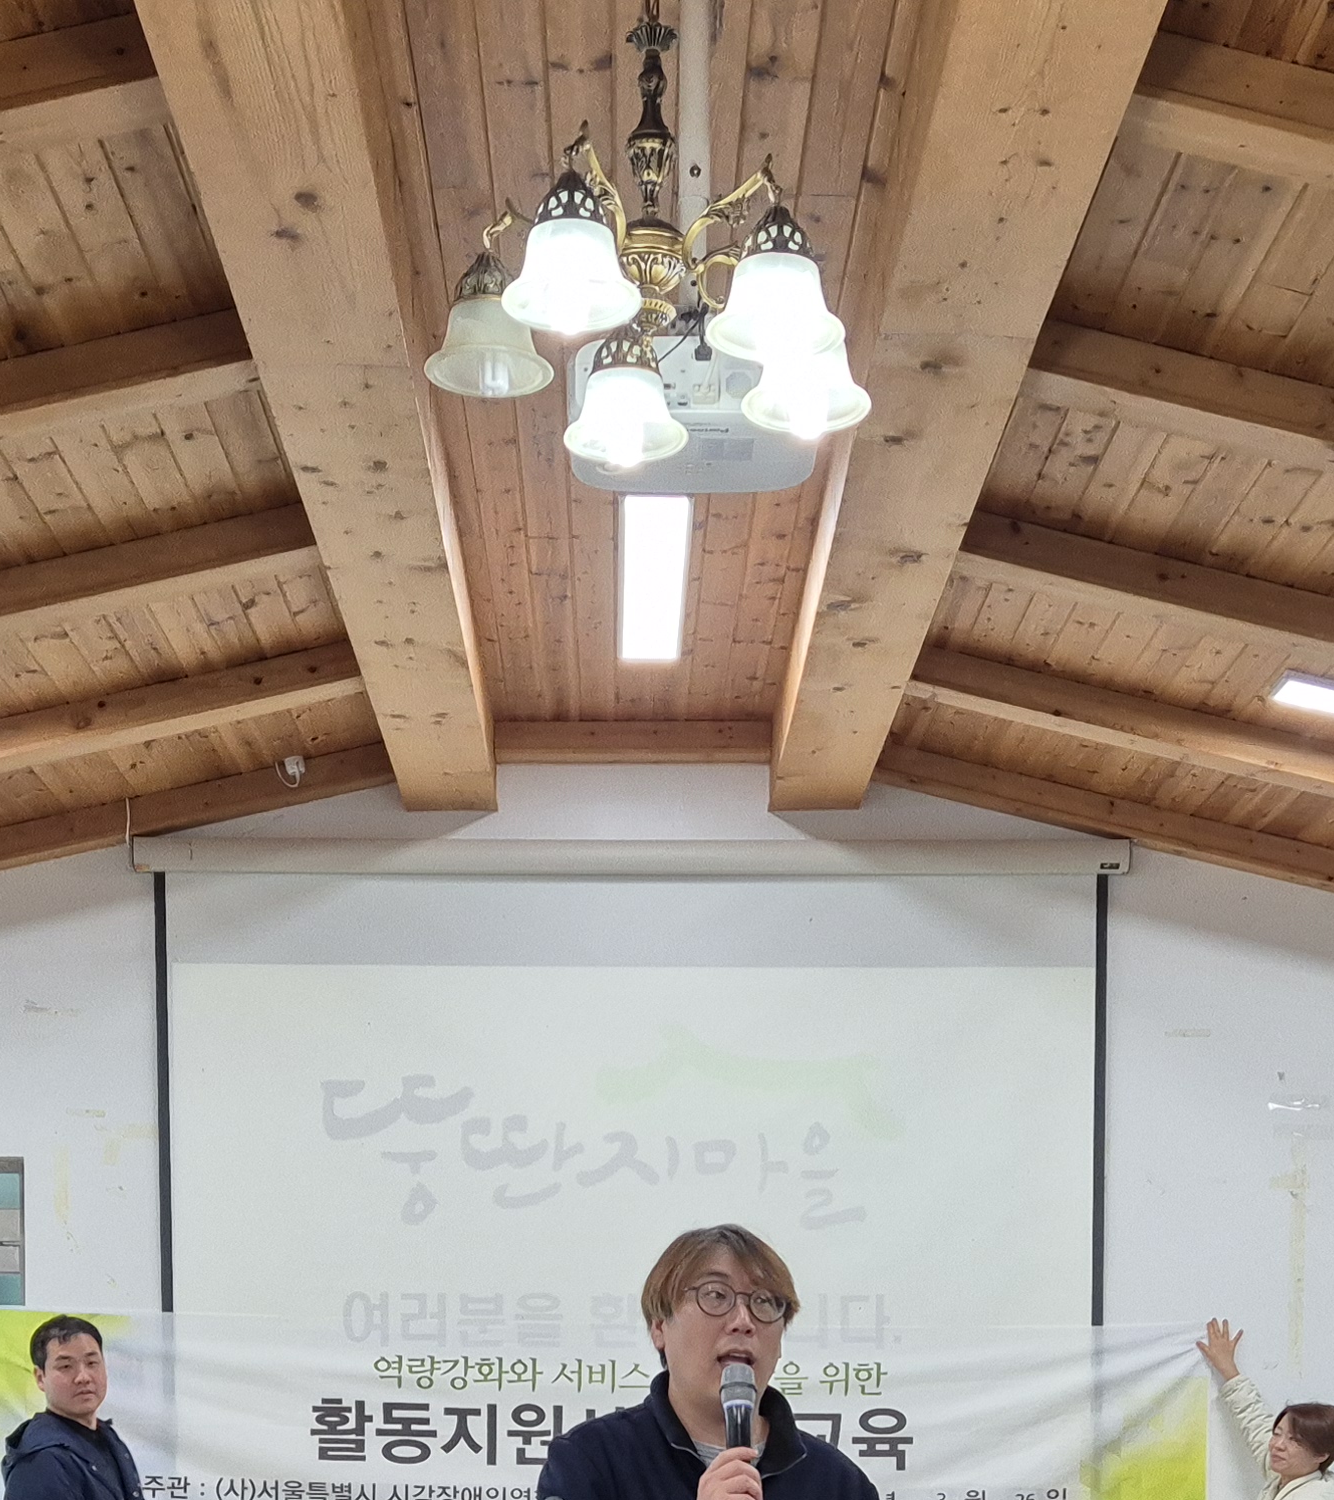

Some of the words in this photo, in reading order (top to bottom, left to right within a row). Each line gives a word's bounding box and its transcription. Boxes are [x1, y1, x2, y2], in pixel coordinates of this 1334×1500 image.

[319, 1073, 866, 1230] 뚱딴지마을
[343, 1290, 564, 1349] 여러분을
[588, 1290, 904, 1350] 환니다.
[372, 1354, 544, 1393] 역량강화와
[819, 1361, 888, 1397] 위한
[309, 1397, 625, 1467] 활동지원
[142, 1475, 191, 1499] 주관
